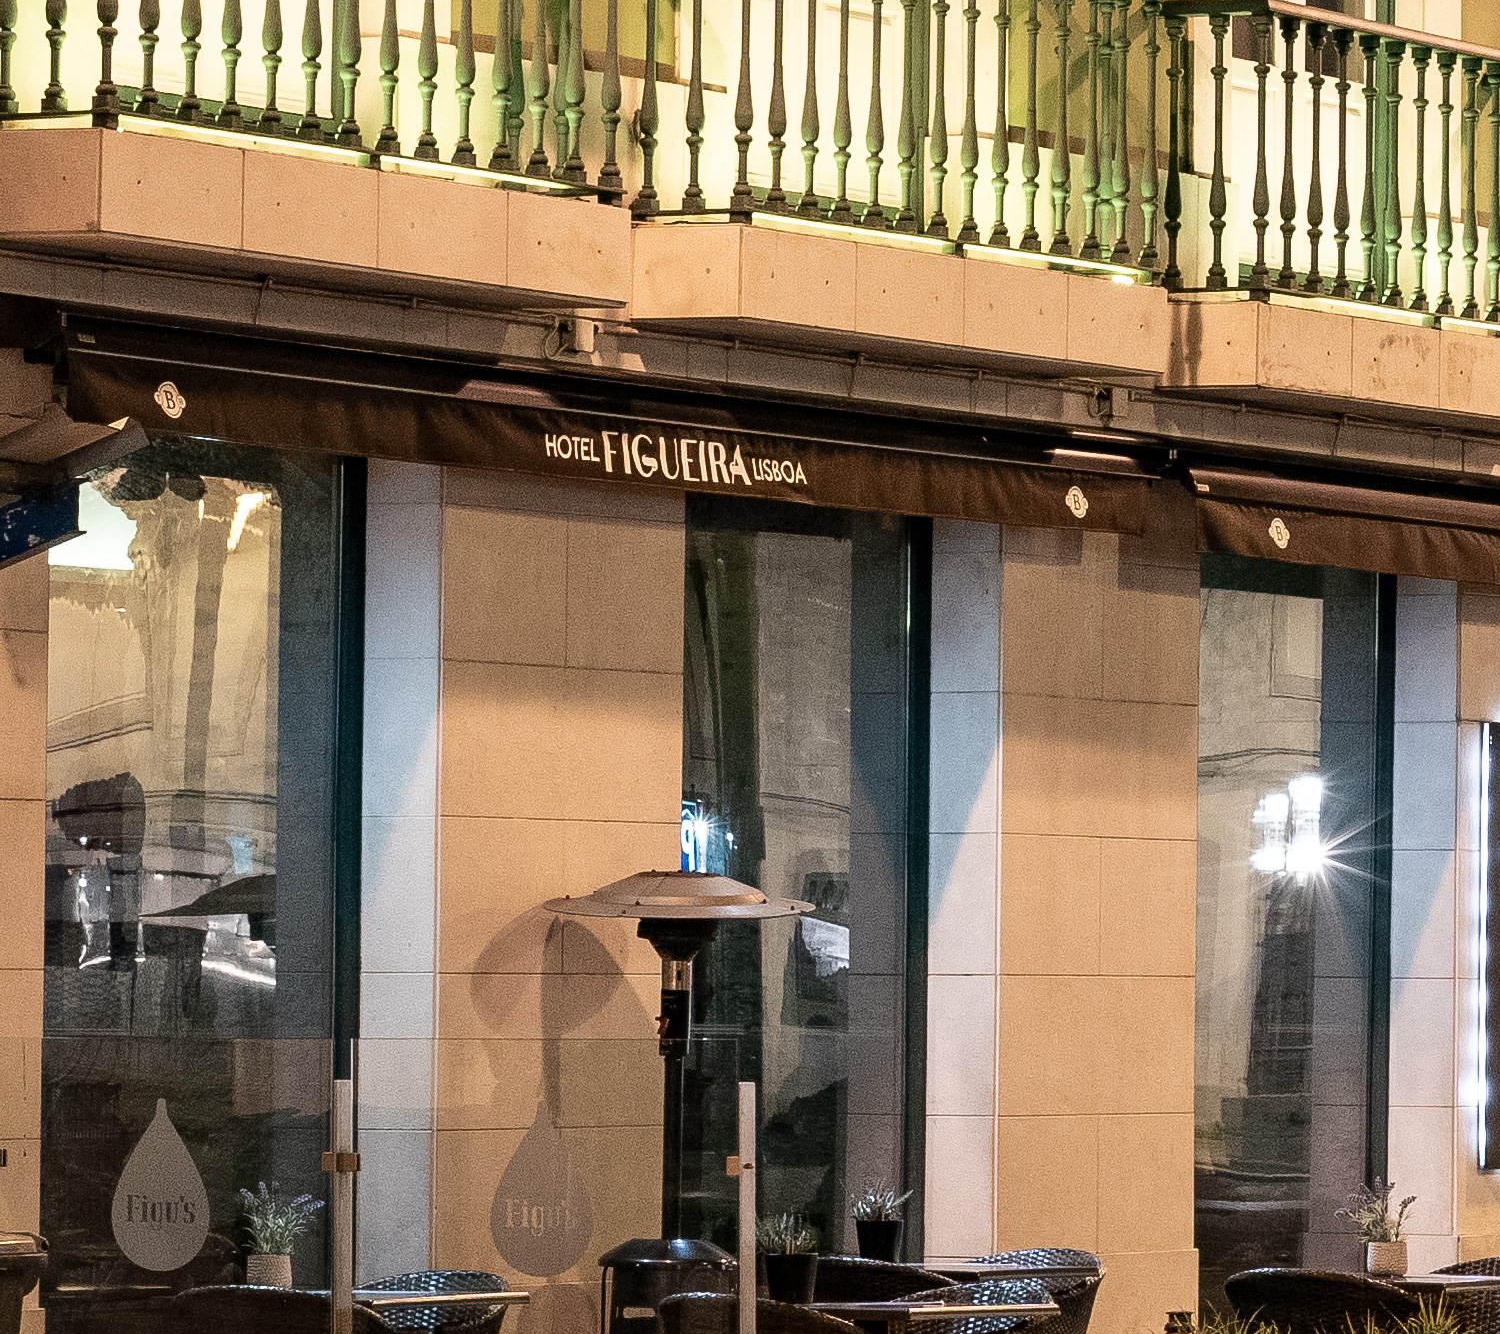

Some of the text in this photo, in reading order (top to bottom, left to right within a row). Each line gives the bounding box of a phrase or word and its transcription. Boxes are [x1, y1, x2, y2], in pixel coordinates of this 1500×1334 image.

[545, 430, 807, 486] HOTEL FIGUEIRA LISBOA
